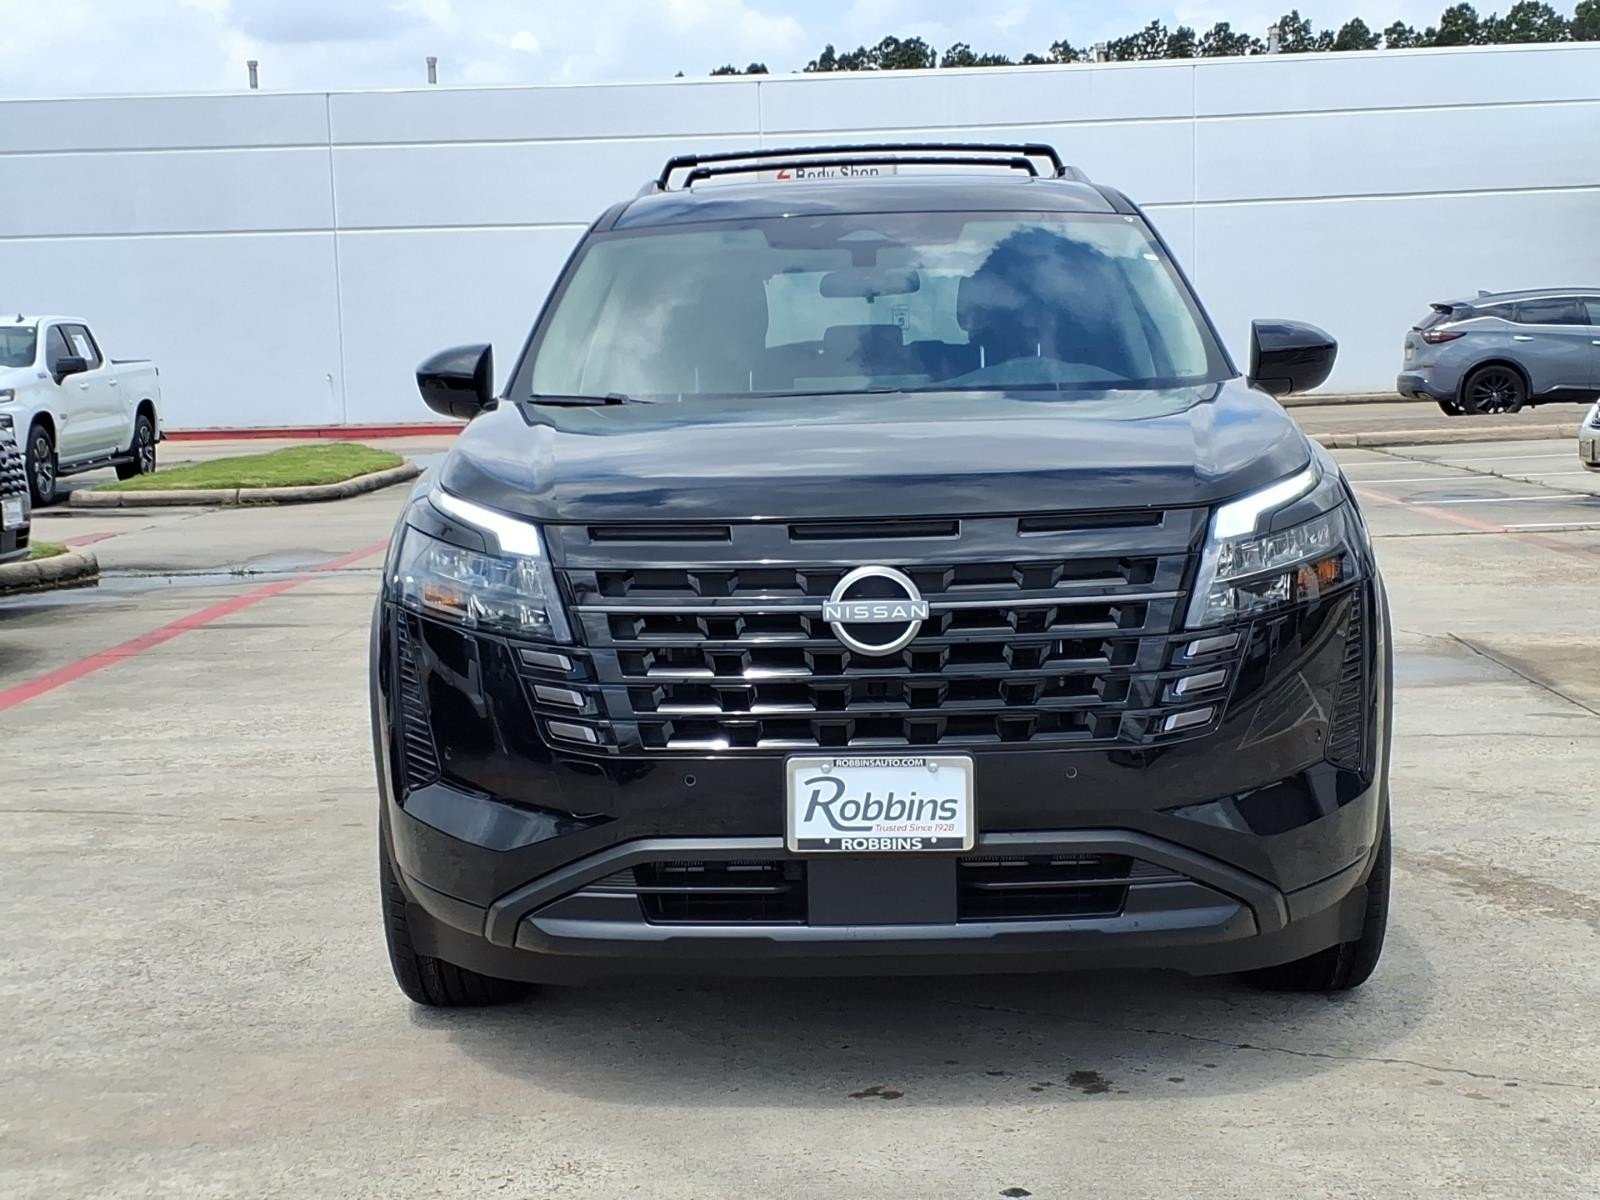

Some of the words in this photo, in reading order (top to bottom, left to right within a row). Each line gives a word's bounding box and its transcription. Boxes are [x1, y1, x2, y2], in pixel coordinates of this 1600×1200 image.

[826, 605, 926, 619] NISSAN
[835, 759, 924, 767] ROBBINSAUTO.COM
[803, 776, 958, 832] Robbins
[875, 823, 907, 832] Trusted
[909, 823, 933, 832] Since
[934, 823, 955, 832] 1928
[841, 838, 923, 850] ROBBINS
